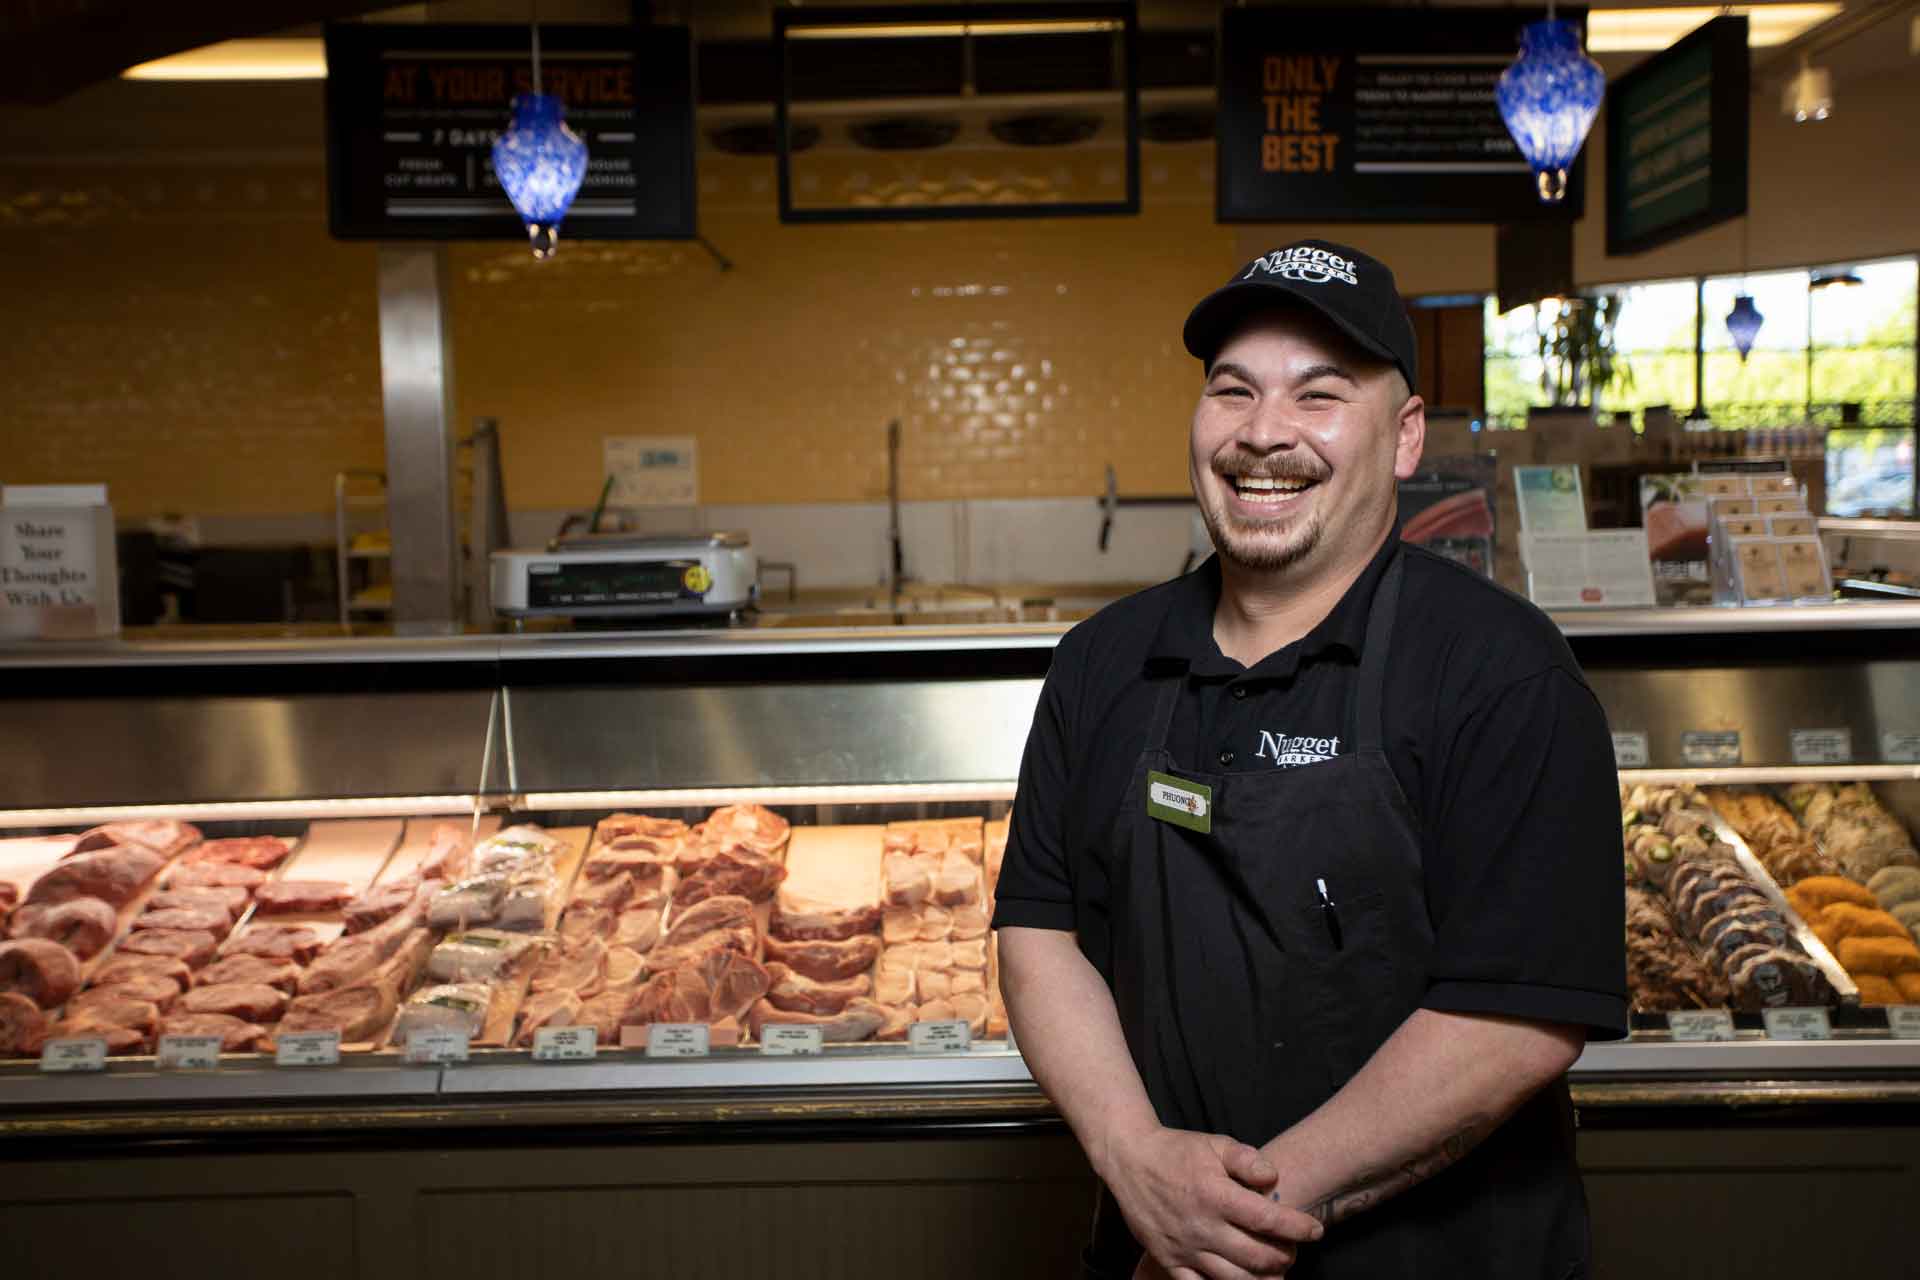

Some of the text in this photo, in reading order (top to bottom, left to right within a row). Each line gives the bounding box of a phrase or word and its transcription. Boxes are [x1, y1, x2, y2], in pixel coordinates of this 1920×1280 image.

[384, 66, 417, 101] AT
[428, 66, 506, 101] YOUR
[1262, 56, 1340, 91] ONLY
[1262, 96, 1323, 131] THE
[1261, 134, 1341, 174] BEST
[1243, 246, 1357, 279] Nugget
[14, 521, 64, 538] Share
[20, 543, 64, 561] Your
[3, 567, 87, 587] Thoughts
[7, 589, 54, 609] With
[1255, 730, 1341, 760] Nugget
